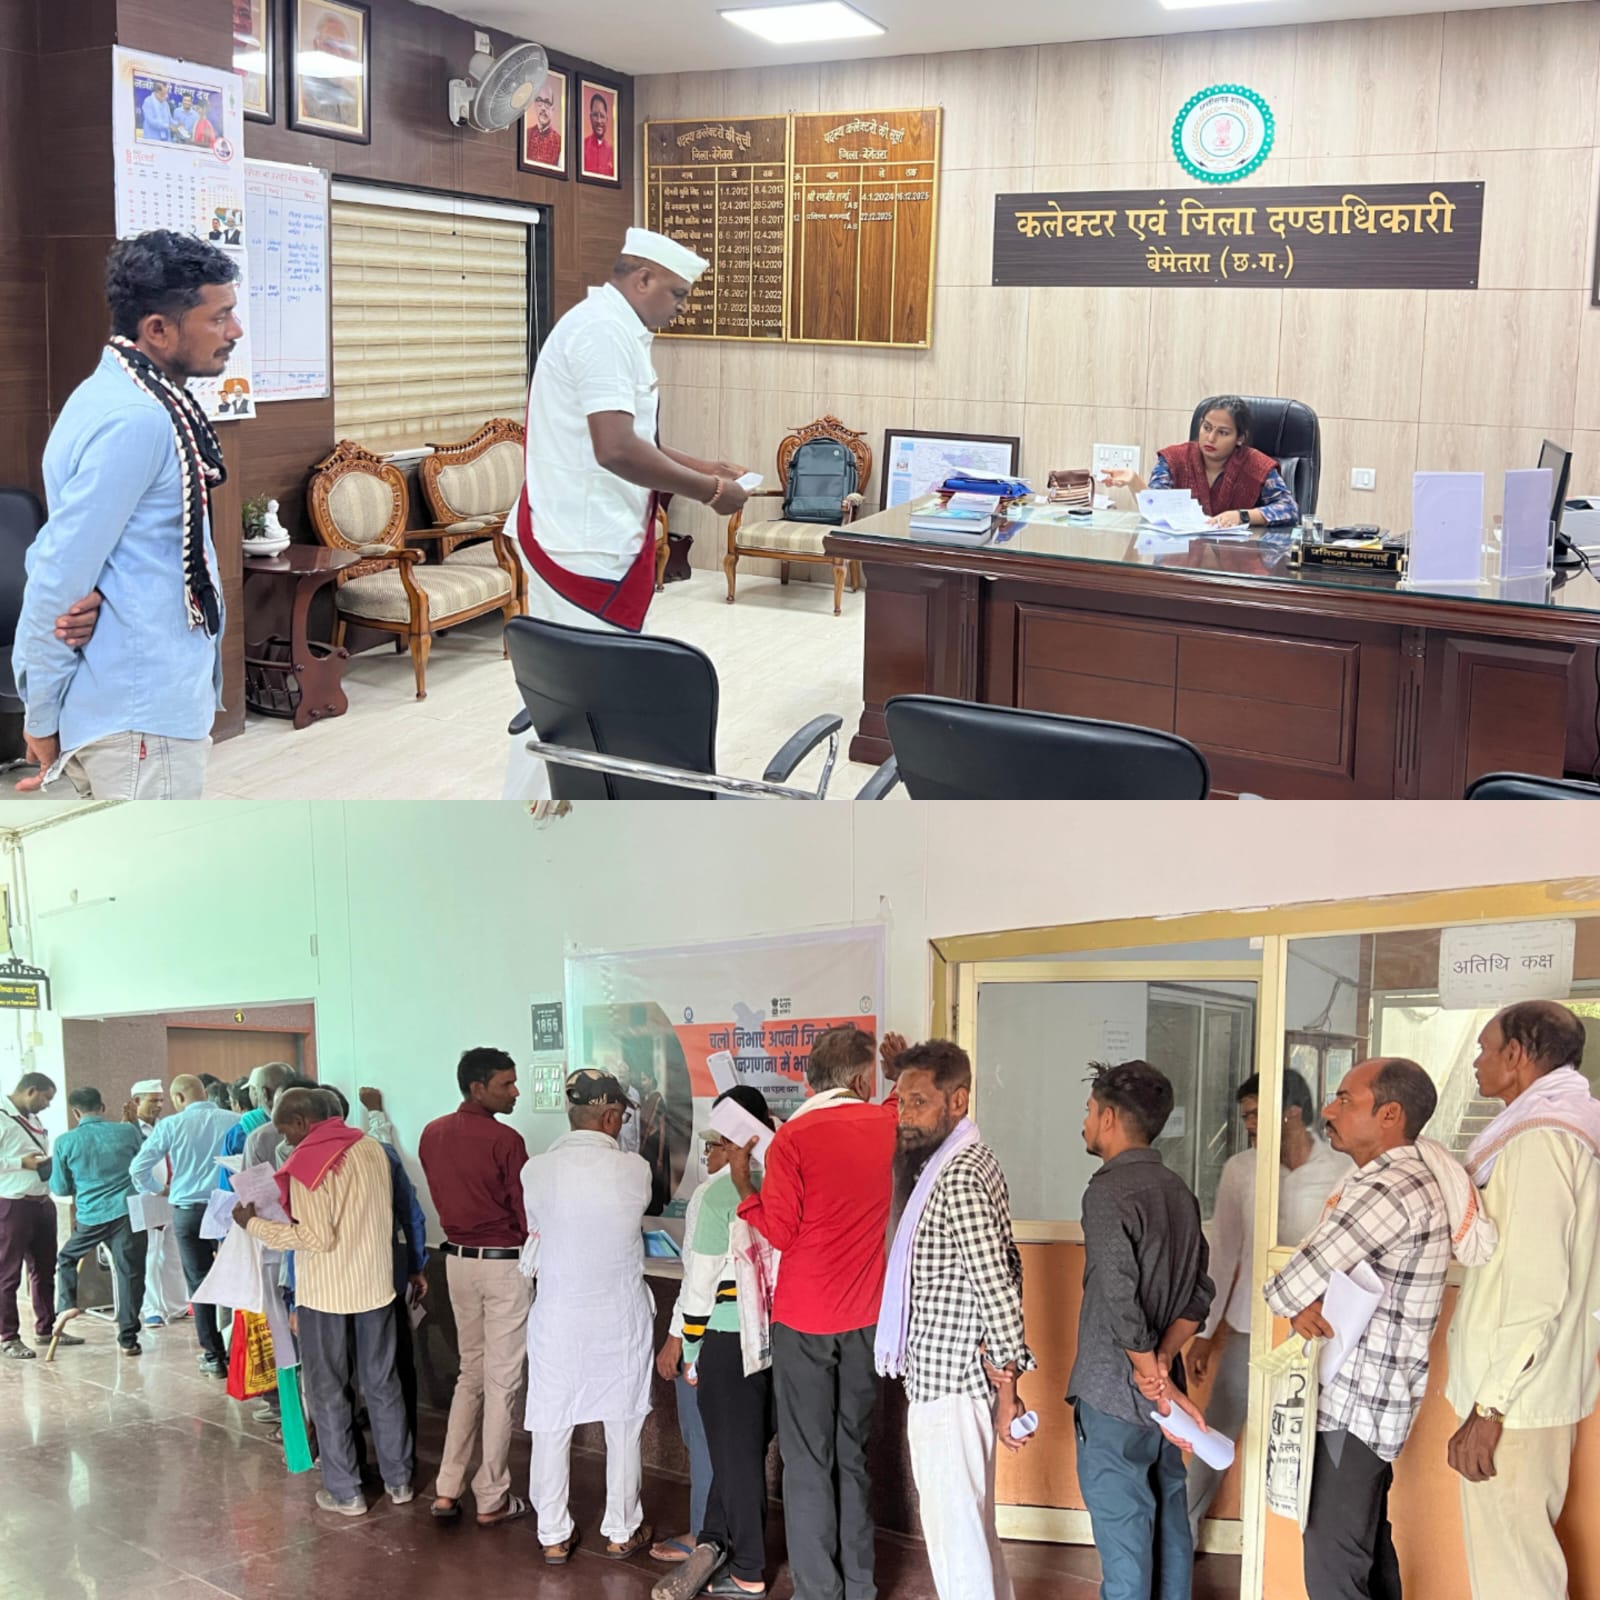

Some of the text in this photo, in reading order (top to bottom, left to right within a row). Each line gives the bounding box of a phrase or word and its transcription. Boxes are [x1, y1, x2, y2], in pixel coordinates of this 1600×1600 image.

[725, 126, 735, 143] की
[735, 130, 752, 152] सूची
[878, 121, 889, 139] की
[719, 186, 749, 197] 1.1.2012
[1014, 191, 1456, 241] कलेक्टर एवं जिला दण्डाधिकारी
[1145, 246, 1211, 273] बेमेतरा
[1453, 953, 1555, 975] अतिथि कक्ष
[709, 1028, 730, 1048] चलो
[732, 1026, 766, 1048] निभाएं
[768, 1023, 799, 1047] अपनी
[734, 1056, 777, 1073] नगणना
[779, 1050, 791, 1073] में
